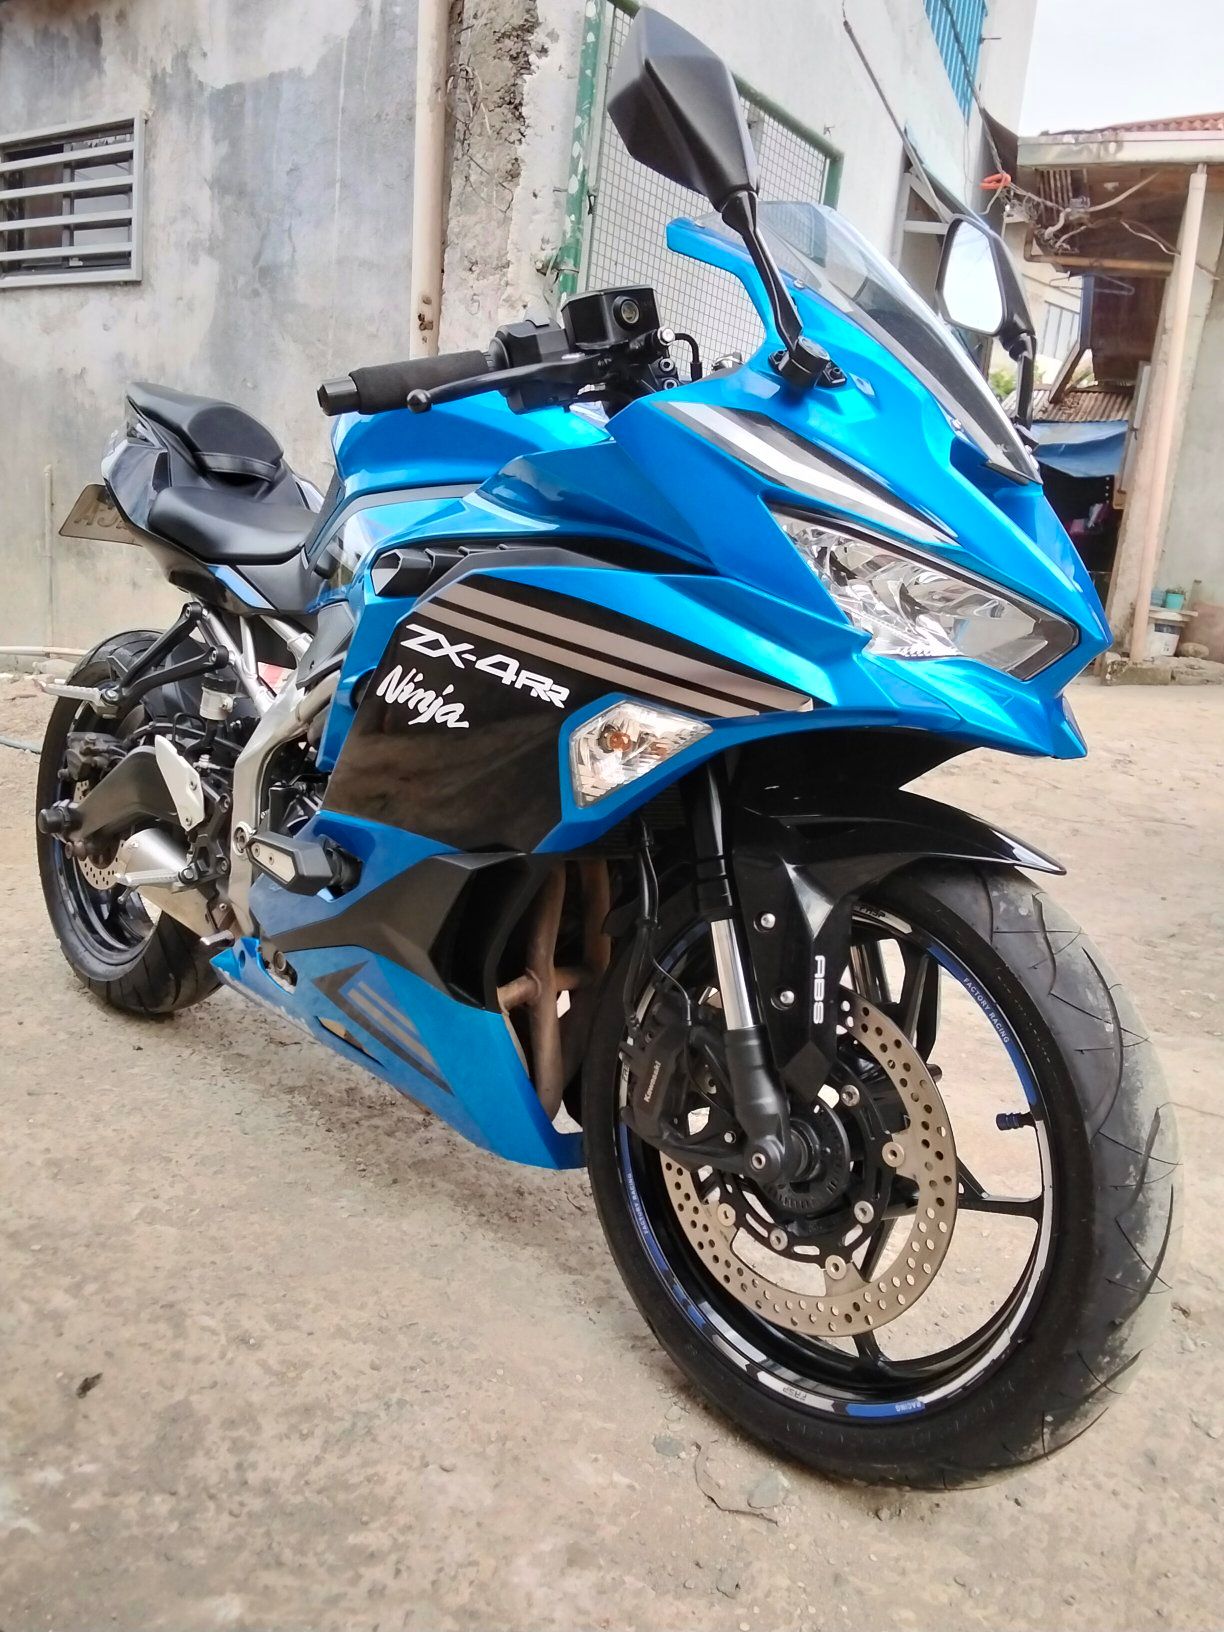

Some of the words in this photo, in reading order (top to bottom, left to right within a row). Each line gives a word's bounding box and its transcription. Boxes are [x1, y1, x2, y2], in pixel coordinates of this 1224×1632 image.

[376, 664, 469, 728] Ninja
[812, 954, 827, 1025] ABS
[962, 977, 991, 1012] FACTORY
[987, 1011, 1010, 1044] RACING
